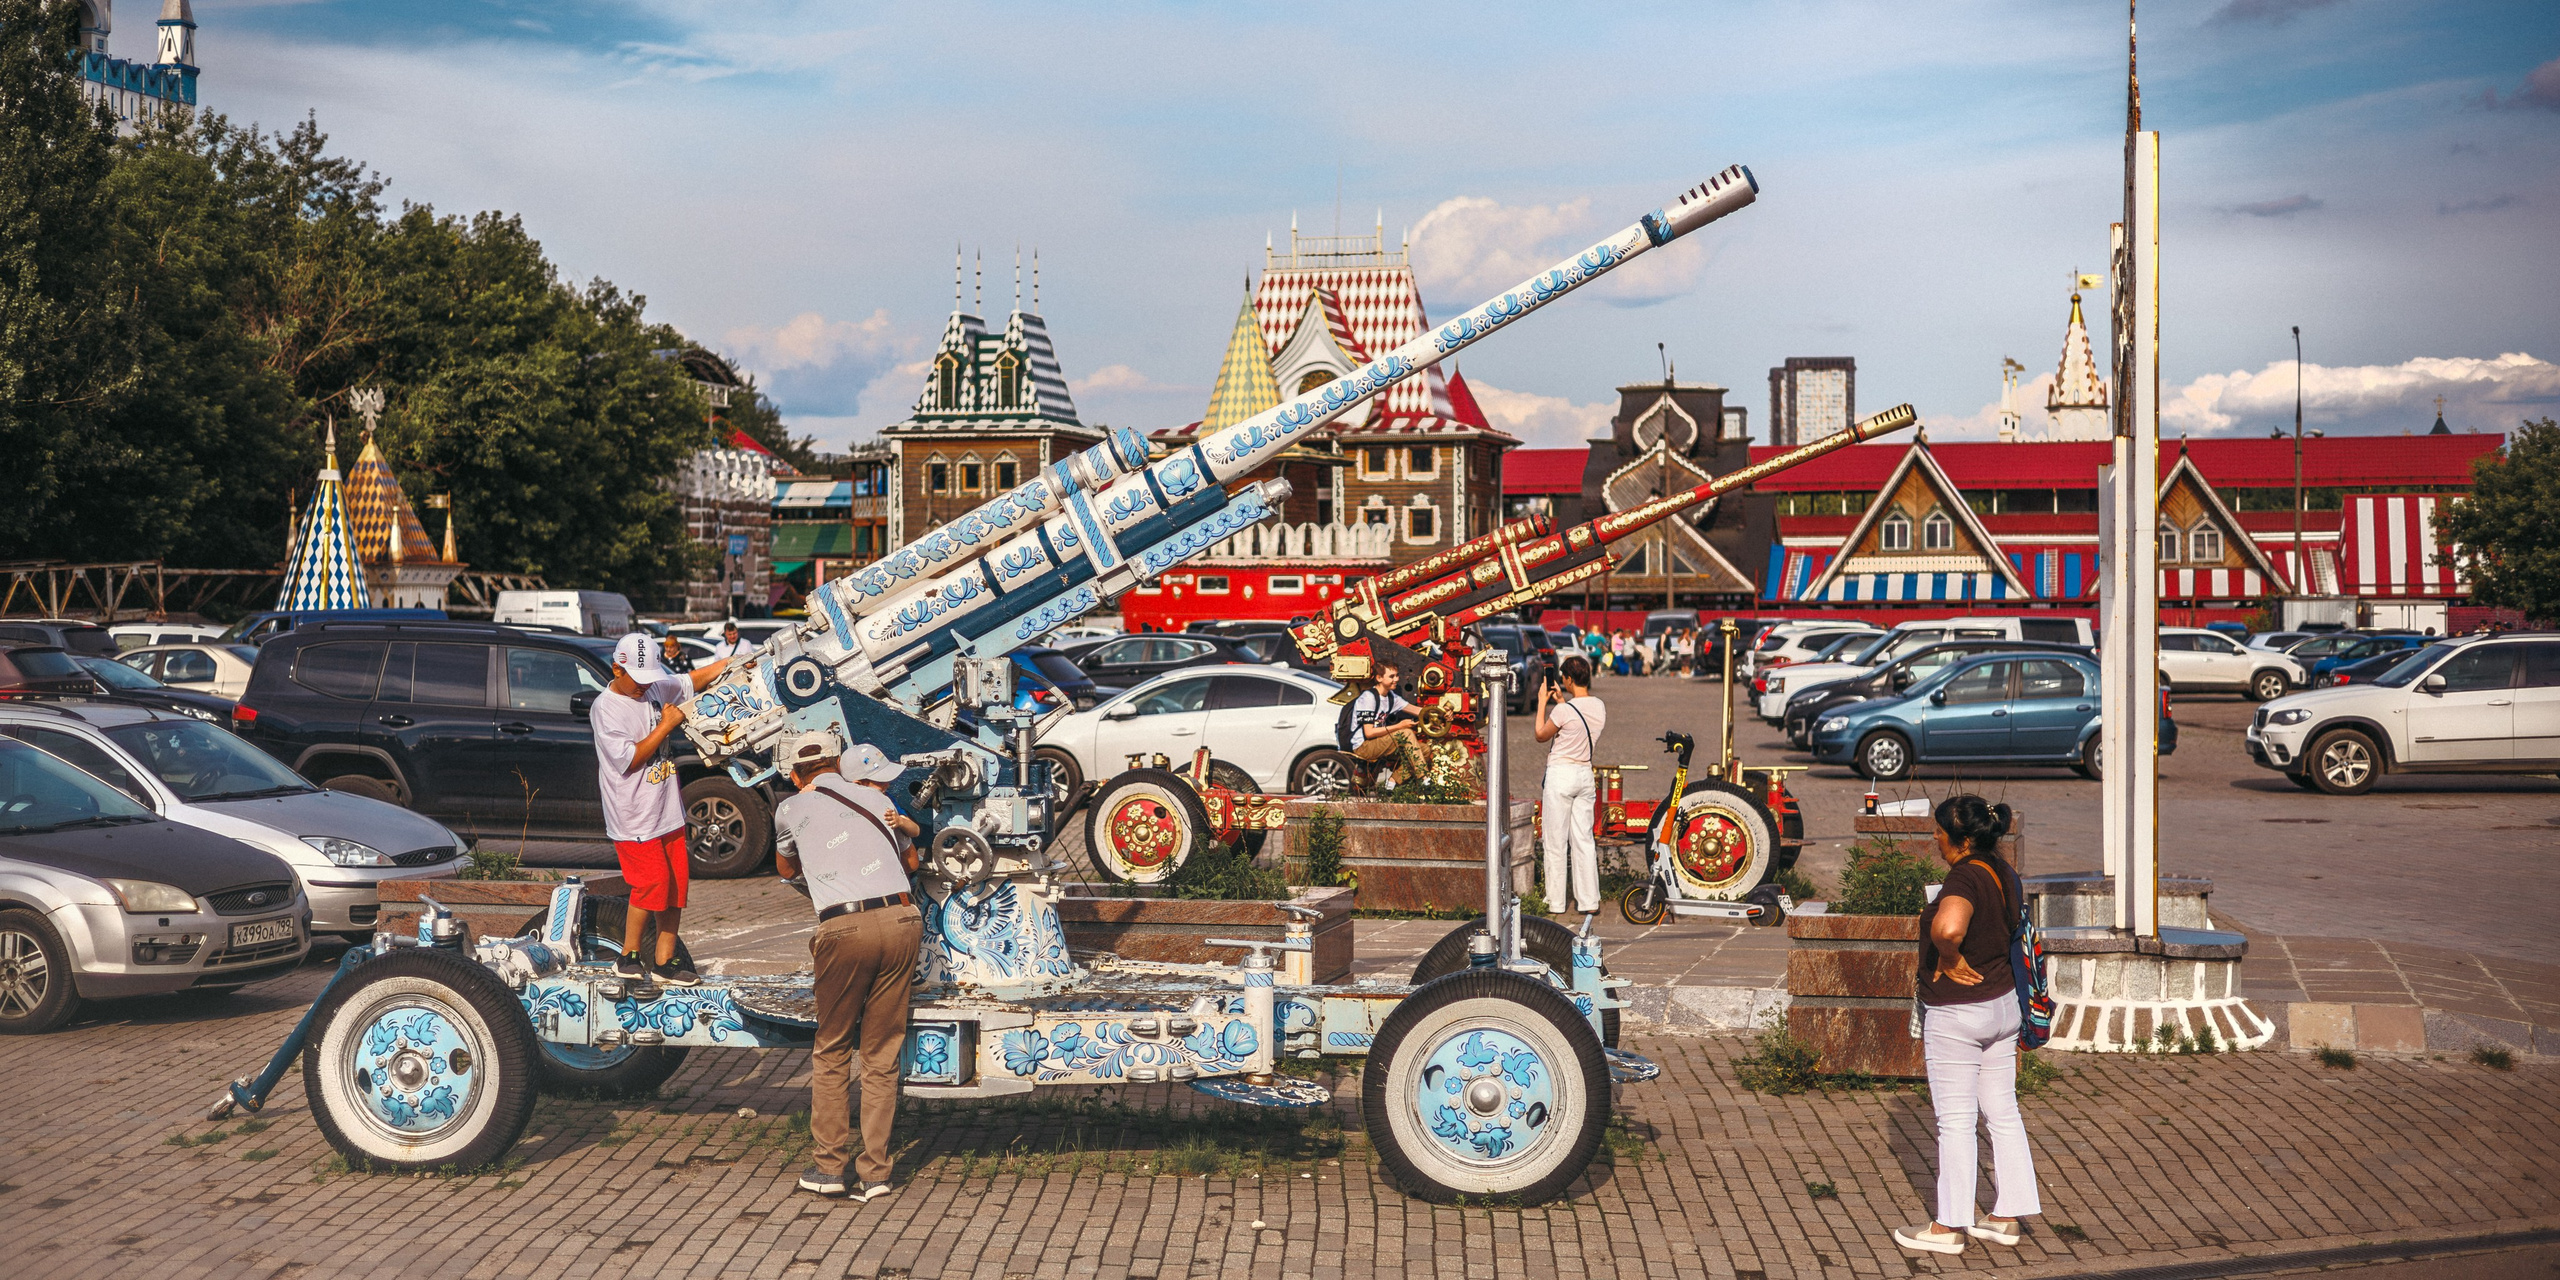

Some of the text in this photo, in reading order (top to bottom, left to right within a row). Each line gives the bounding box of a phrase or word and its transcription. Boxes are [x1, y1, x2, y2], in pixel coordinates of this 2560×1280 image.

[637, 638, 646, 669] adidas
[1672, 770, 1686, 806] WHOOSH
[276, 919, 291, 933] 799
